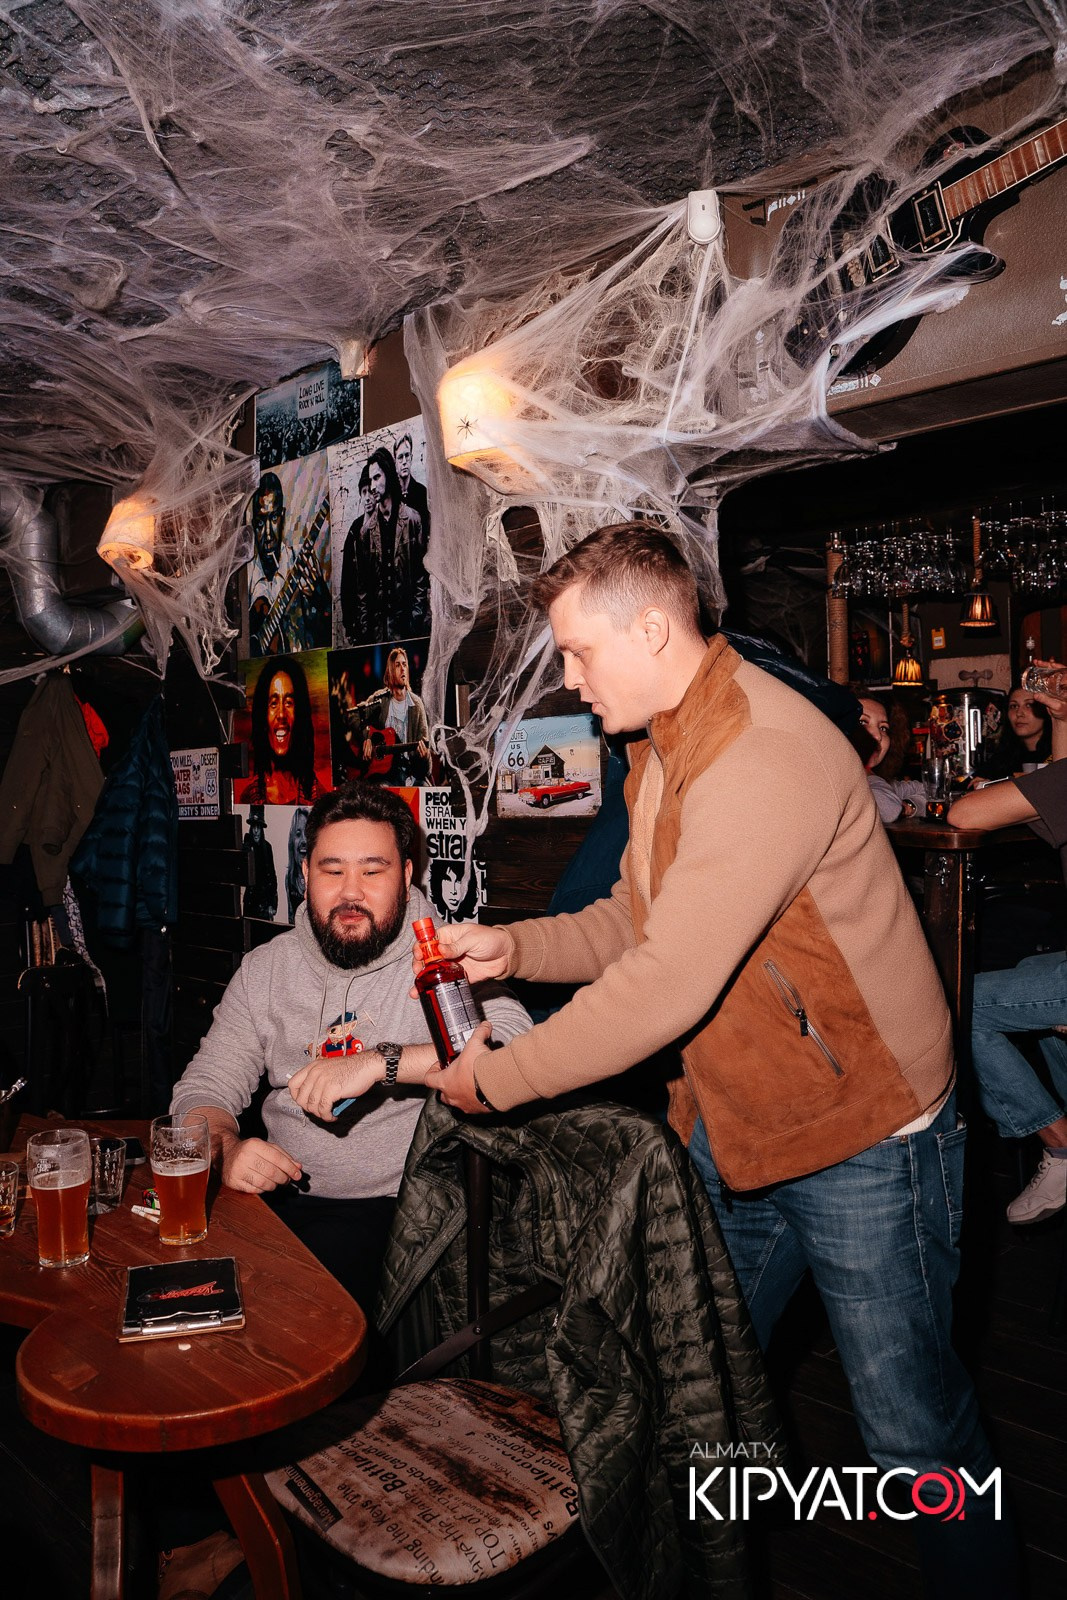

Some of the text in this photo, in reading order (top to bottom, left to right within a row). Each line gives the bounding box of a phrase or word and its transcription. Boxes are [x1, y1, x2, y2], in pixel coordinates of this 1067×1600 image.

[299, 380, 325, 399] LONG LIVE
[299, 400, 309, 410] ROCK
[315, 392, 325, 404] ROLL
[201, 753, 217, 766] DESERT
[507, 751, 525, 768] 66
[538, 756, 554, 764] CAFE
[208, 780, 215, 793] 66
[425, 792, 451, 806] PEO
[425, 806, 453, 818] STRA
[426, 818, 456, 831] WHEN
[355, 1043, 363, 1053] 3
[484, 1432, 537, 1459] Express
[406, 1466, 448, 1495] Words
[361, 1498, 391, 1527] Keys
[386, 1523, 410, 1545] the
[474, 1528, 507, 1568] TOP
